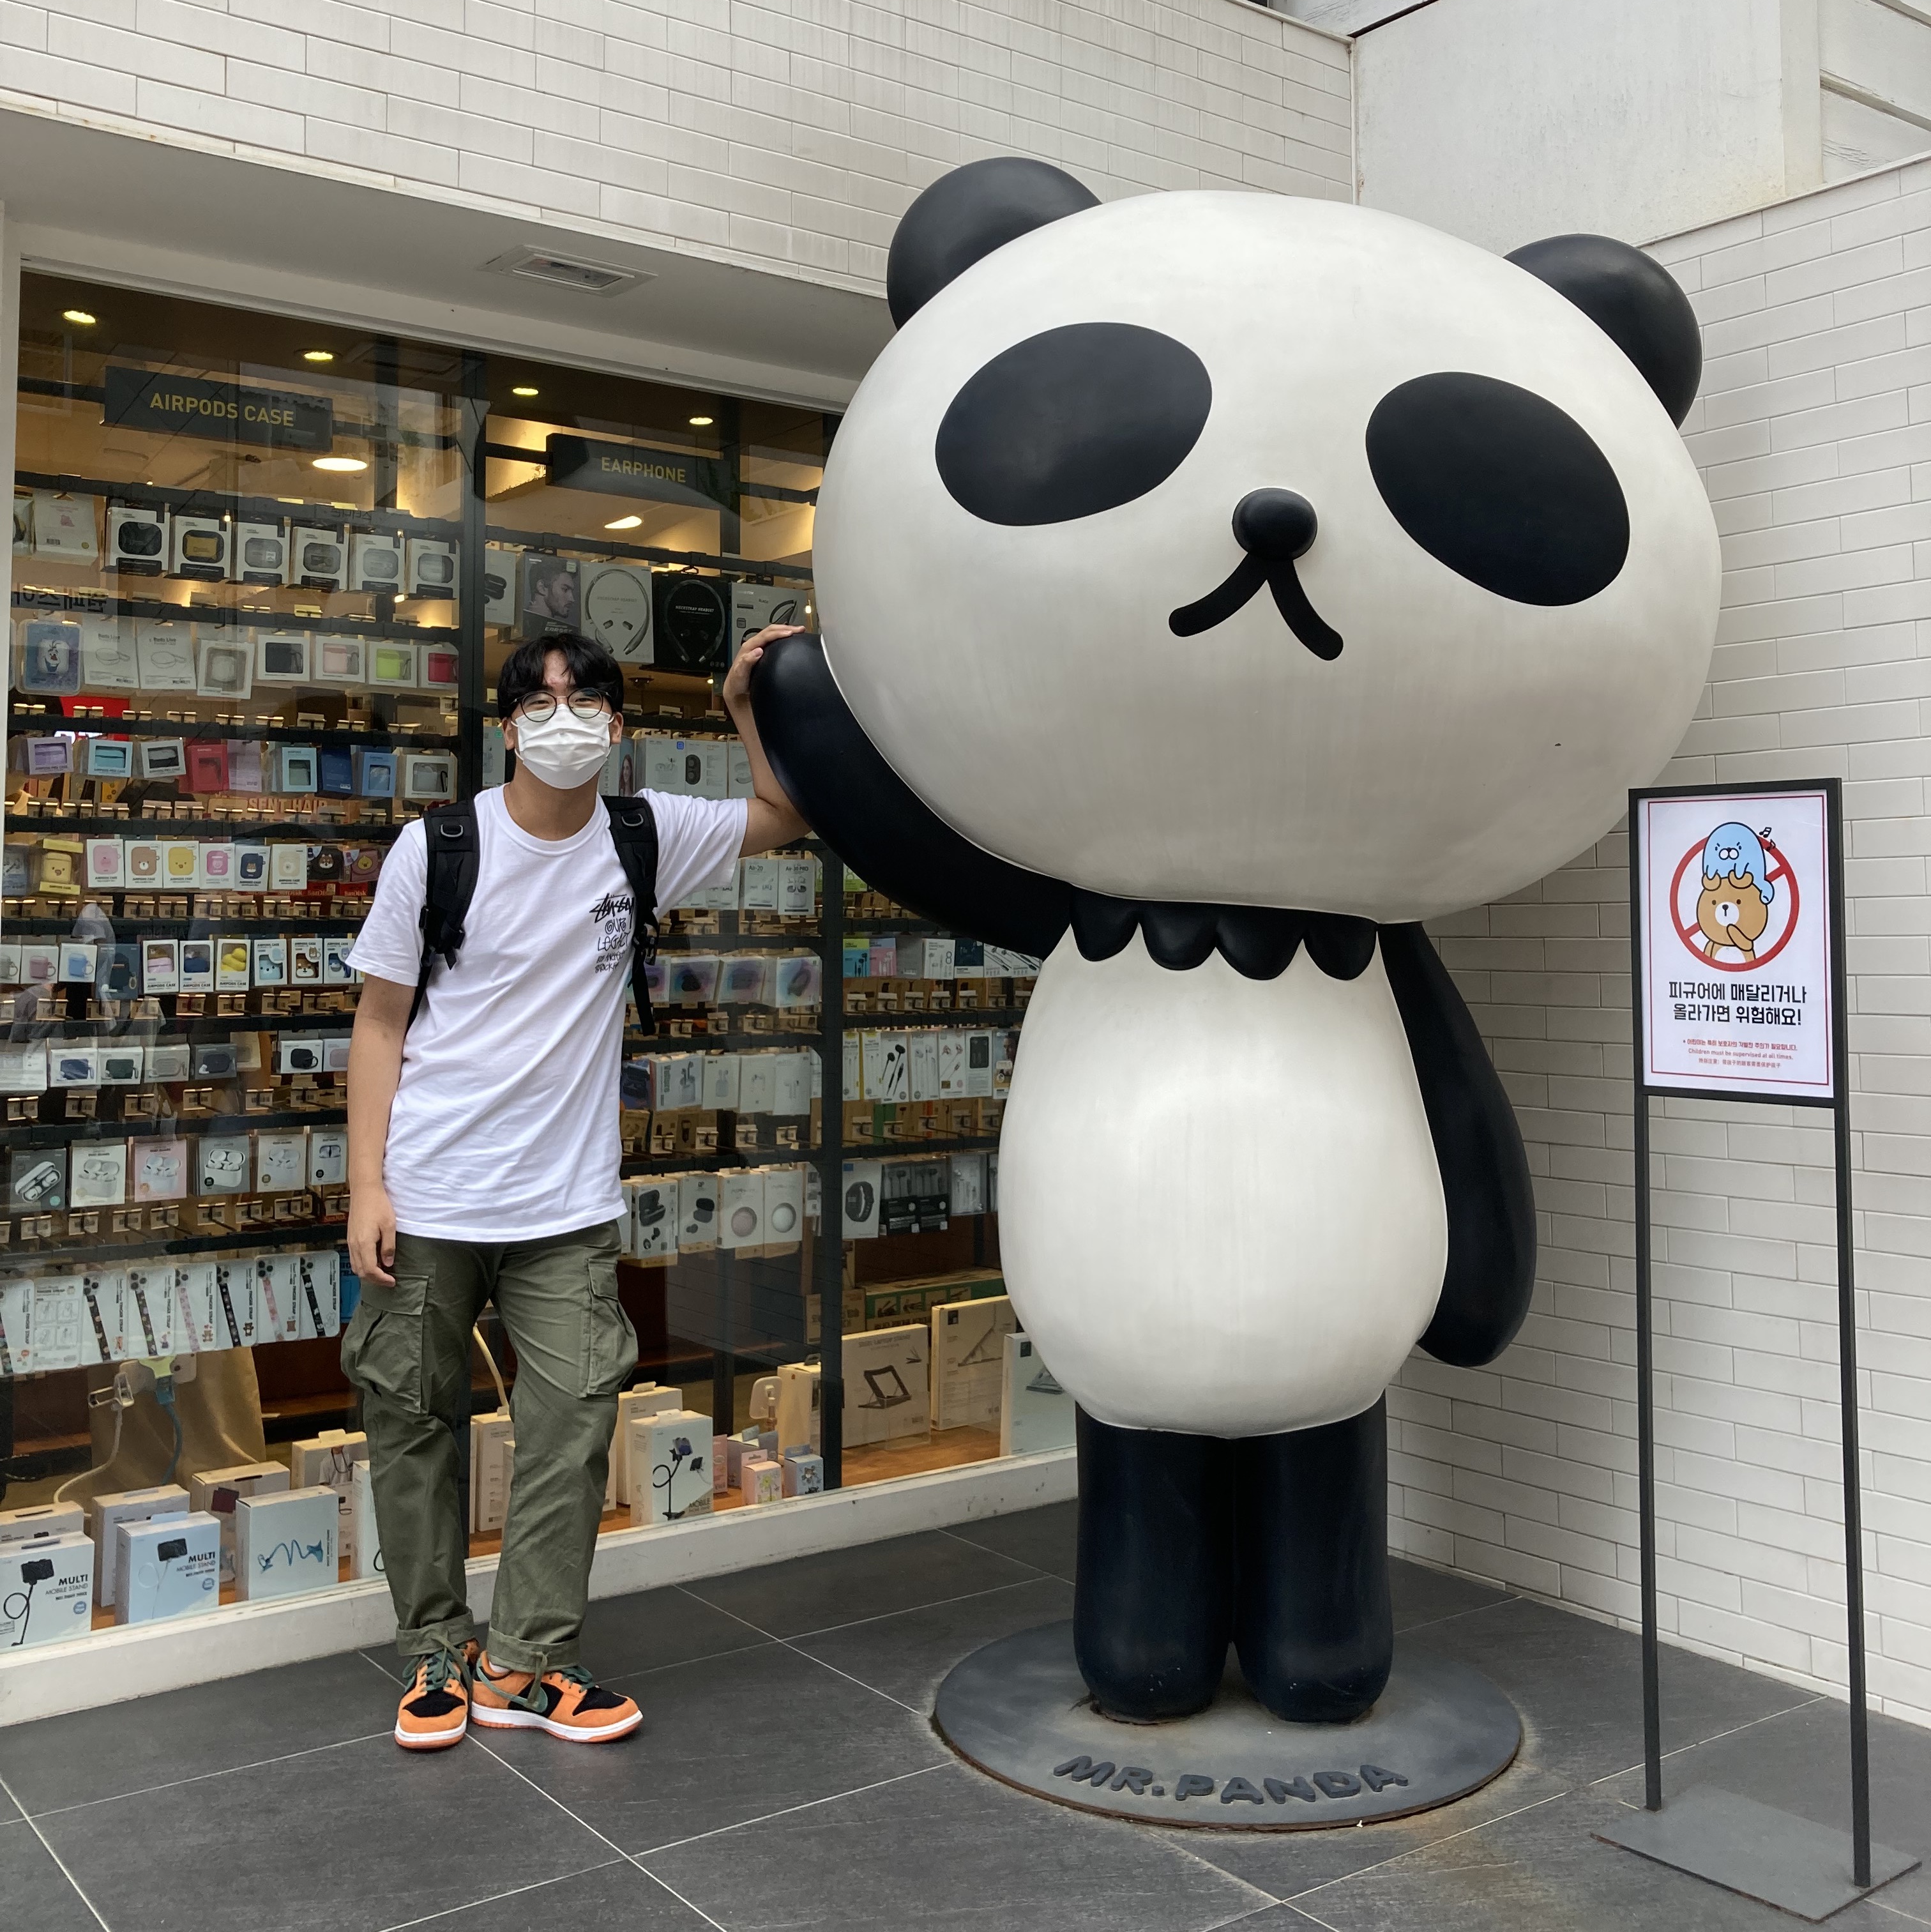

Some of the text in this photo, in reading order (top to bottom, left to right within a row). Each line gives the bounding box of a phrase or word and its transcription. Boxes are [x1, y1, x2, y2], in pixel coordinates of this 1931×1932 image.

[150, 392, 294, 427] AIRPODS CASE
[602, 457, 686, 483] EARPHONE
[1669, 982, 1806, 1003] 피규어에 매달리거나
[1674, 1003, 1801, 1025] 올라가면 위험해요!
[188, 1551, 215, 1563] MULTI
[45, 1583, 88, 1595] MOBILE STAND
[59, 1574, 88, 1586] MULTI
